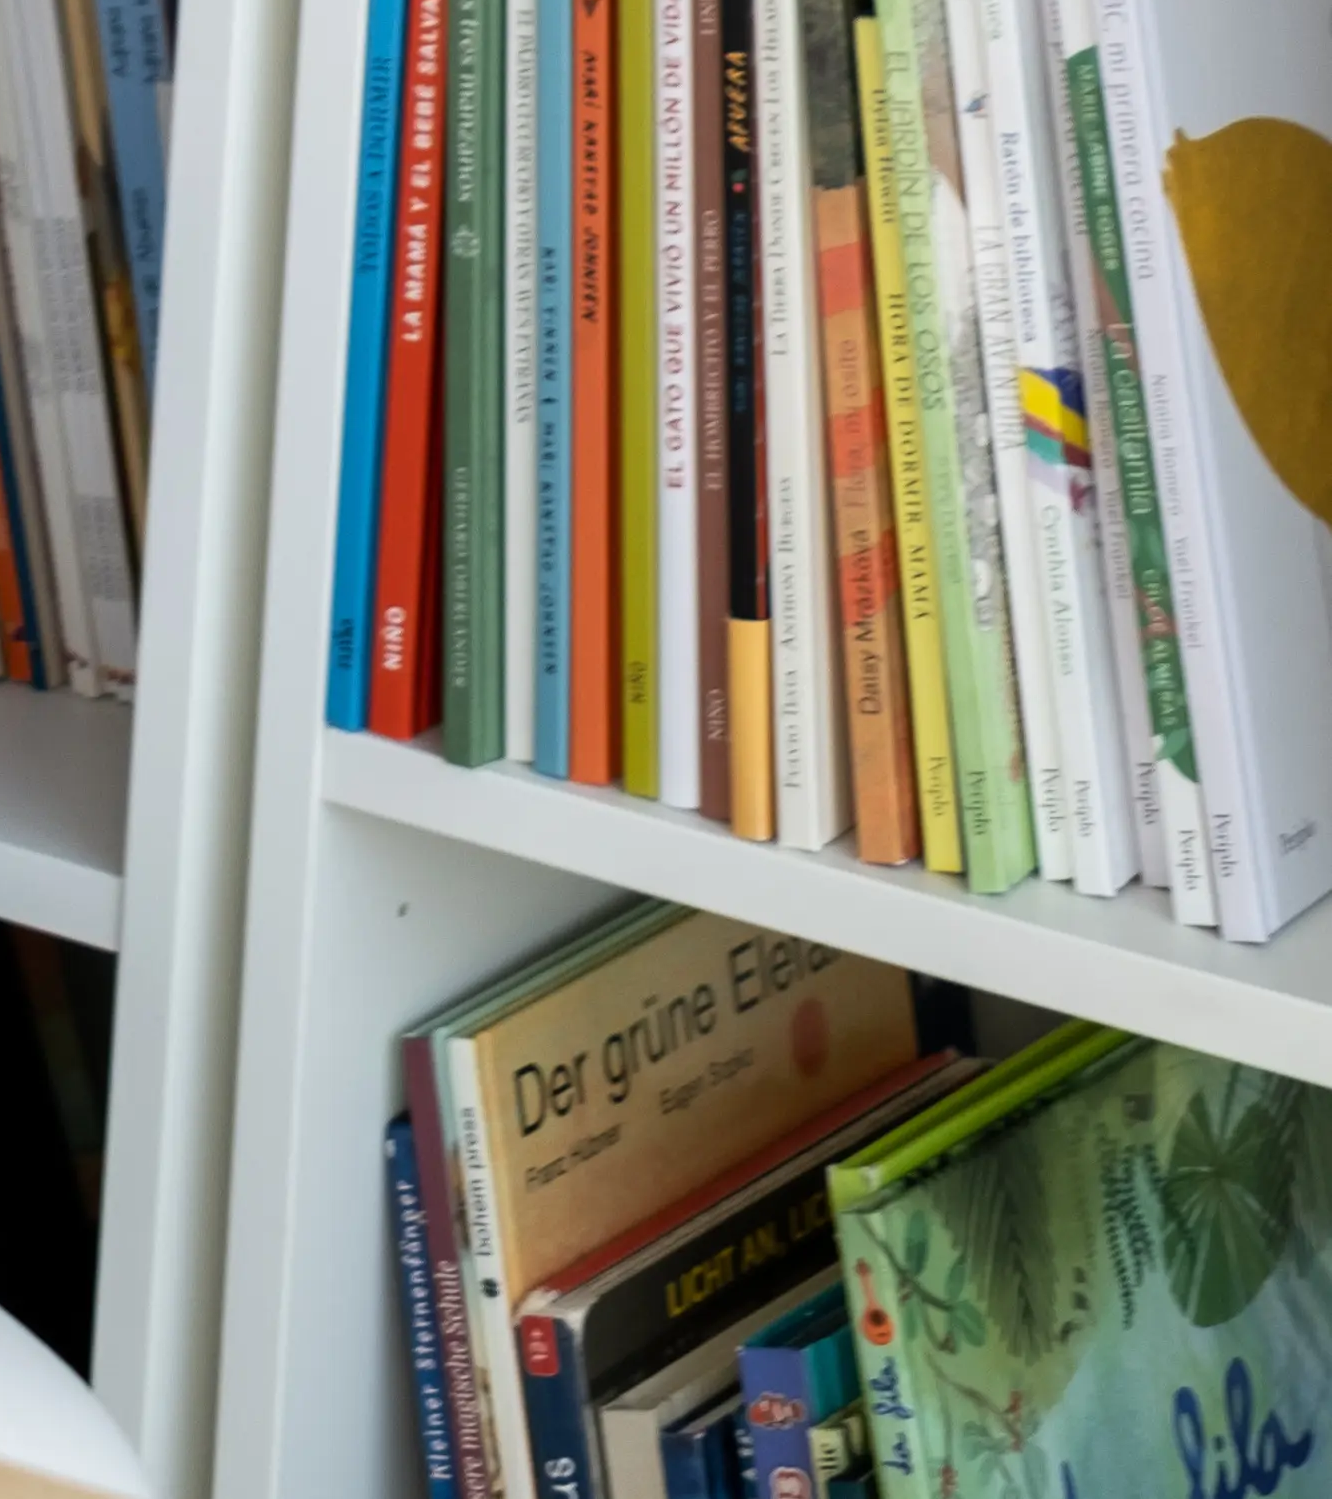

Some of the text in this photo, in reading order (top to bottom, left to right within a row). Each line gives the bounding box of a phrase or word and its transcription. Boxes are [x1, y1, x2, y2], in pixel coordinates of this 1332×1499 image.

[660, 54, 683, 89] DE
[887, 49, 912, 86] EL
[1104, 40, 1129, 74] mi
[403, 82, 437, 152] BEBÉ
[657, 96, 684, 194] MILLÓN
[1107, 81, 1145, 187] primera
[408, 159, 434, 191] EL
[408, 195, 431, 215] Y
[660, 199, 685, 237] UN
[904, 210, 930, 246] DE
[999, 130, 1041, 344] Ratón de biblioteca
[1126, 194, 1157, 282] cocina
[397, 222, 430, 304] MAMÁ
[658, 242, 686, 315] VIVIÓ
[905, 260, 935, 316] LOS
[400, 310, 425, 344] LA
[661, 320, 686, 376] QUE
[885, 291, 913, 365] HORA
[892, 375, 916, 409] DE
[914, 325, 945, 413] OSOS
[661, 383, 686, 454] GATO
[663, 461, 686, 491] EL
[906, 543, 934, 623] MAMÁ
[1036, 503, 1079, 677] Cynthia Alonso
[380, 605, 408, 672] NIÑO
[965, 770, 994, 838] Periplo
[1133, 761, 1163, 827] Periplo
[1175, 828, 1204, 892] Periplo
[1209, 812, 1240, 879] Periplo
[511, 1049, 591, 1140] Der
[600, 982, 717, 1106] grüne
[458, 1104, 495, 1258] bohem press
[664, 1247, 735, 1318] LICHT
[395, 1178, 453, 1481] Kleiner Sternenfänger
[432, 1258, 480, 1451] magische Schule
